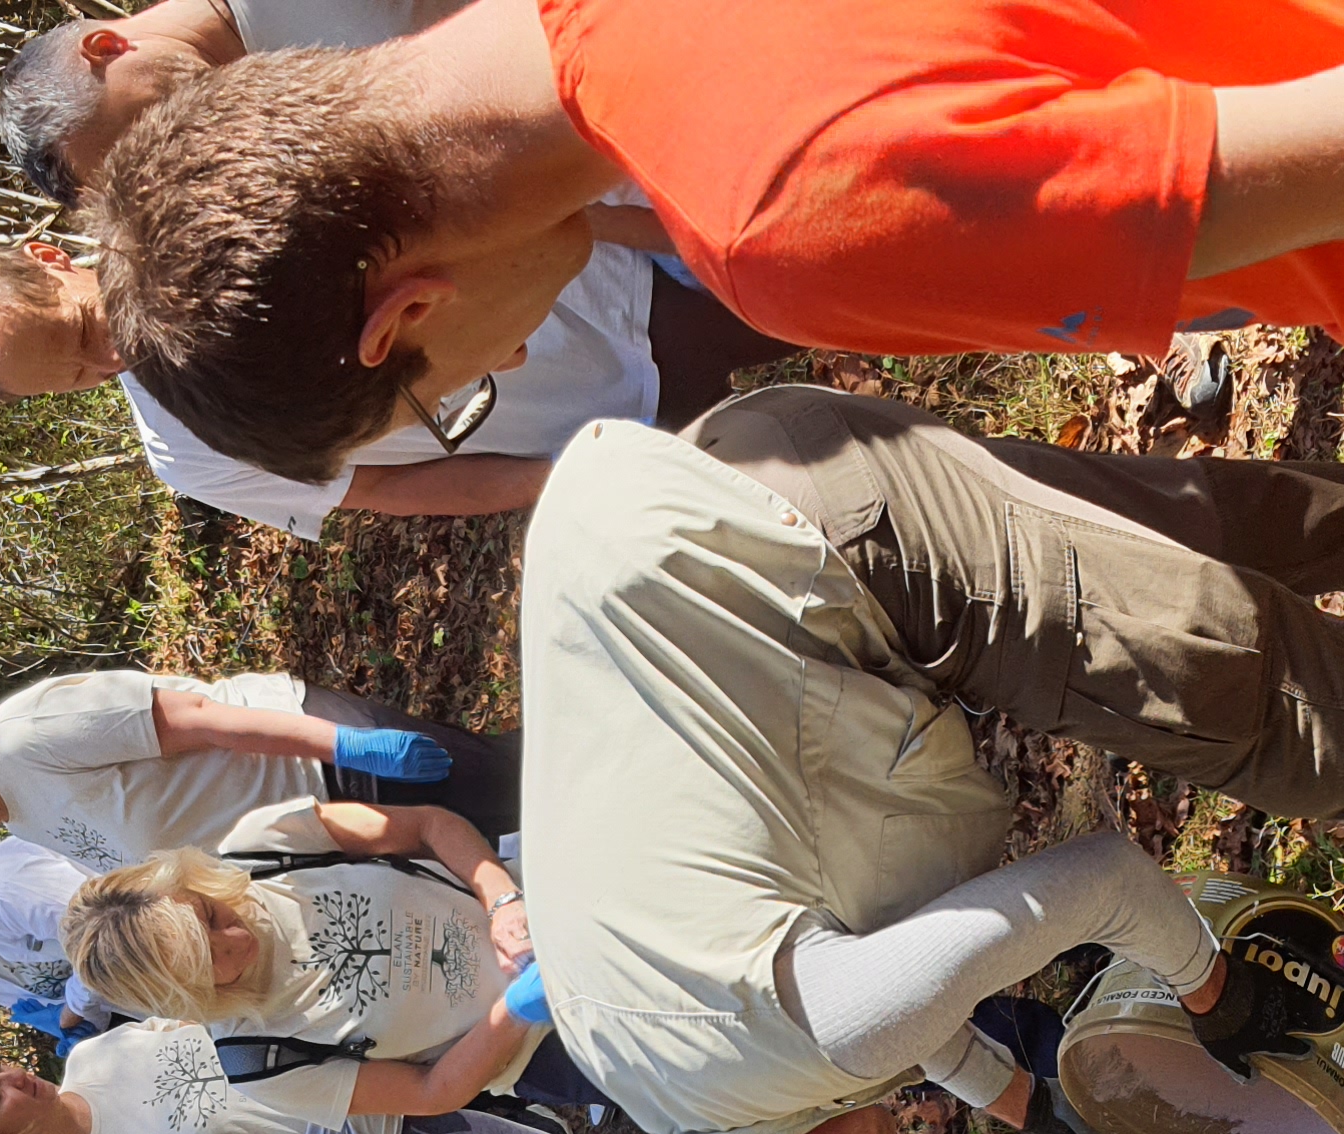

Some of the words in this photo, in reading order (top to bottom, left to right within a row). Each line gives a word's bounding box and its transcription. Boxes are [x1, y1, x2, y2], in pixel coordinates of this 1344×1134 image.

[393, 930, 404, 968] ELAN,
[402, 910, 414, 991] SUSTAINABLE
[414, 918, 422, 968] NATURE
[413, 972, 419, 987] BY
[1141, 990, 1175, 1001] NCED
